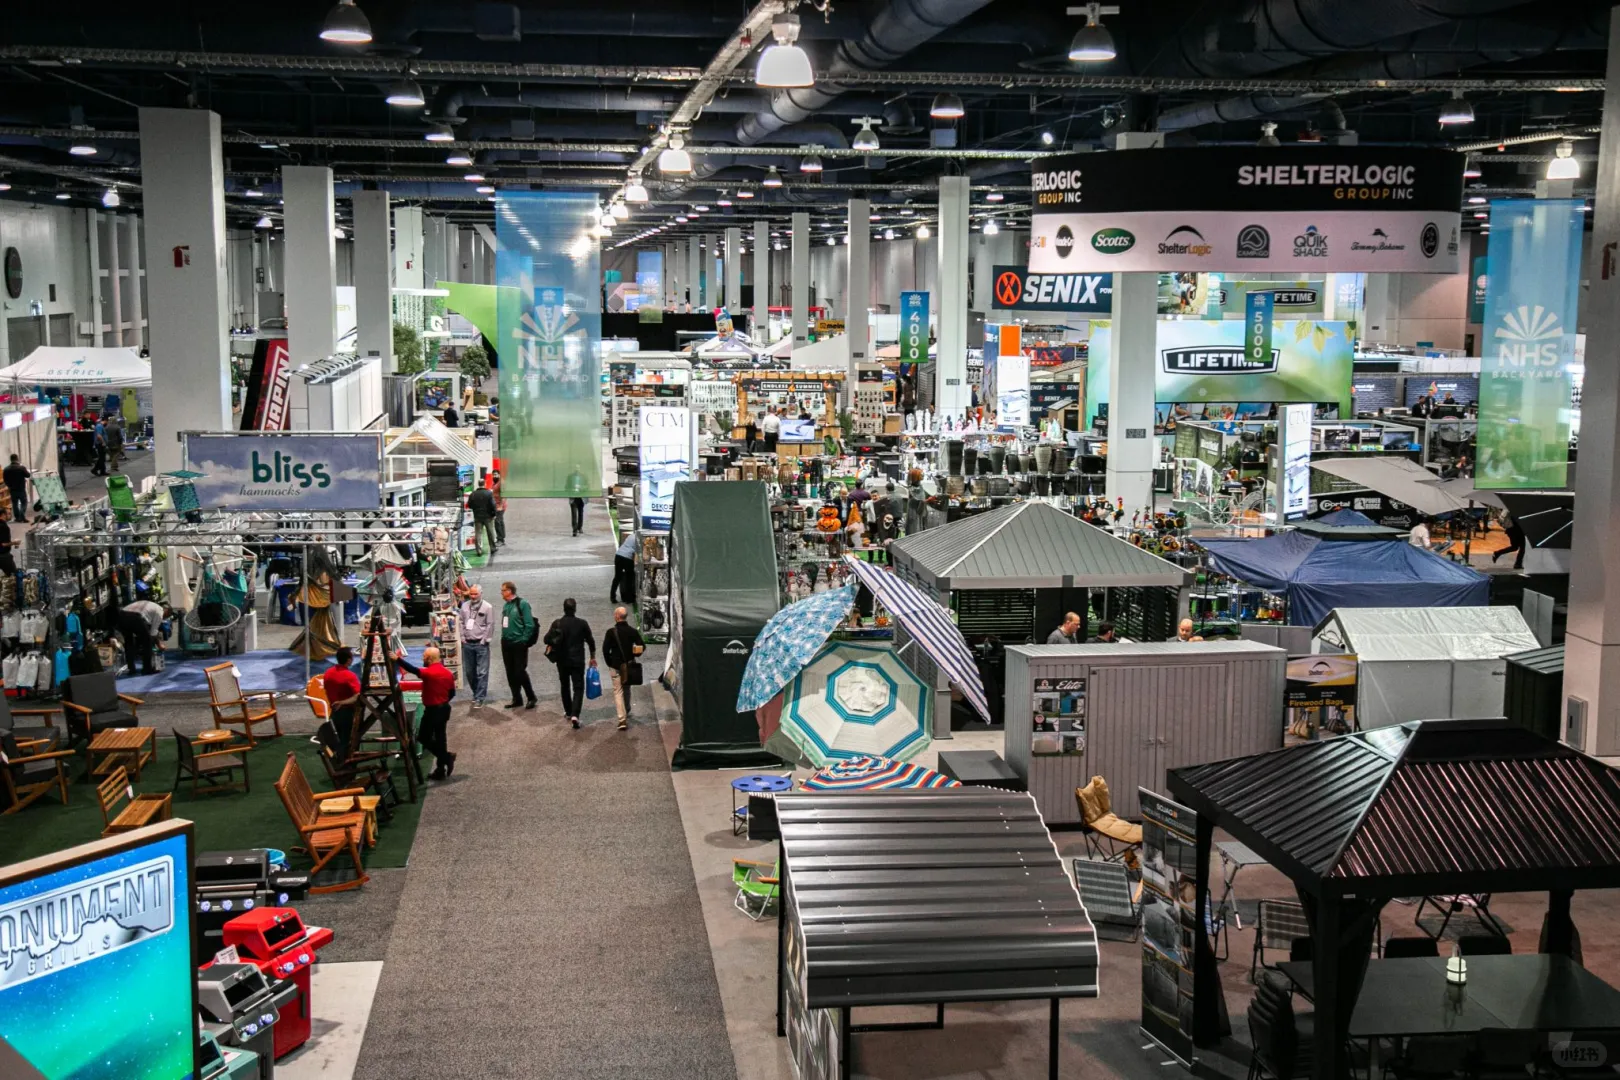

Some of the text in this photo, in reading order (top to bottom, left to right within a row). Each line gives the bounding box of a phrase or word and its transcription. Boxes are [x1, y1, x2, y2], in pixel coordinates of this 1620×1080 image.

[1238, 165, 1415, 185] SHELTERLOGIC
[1095, 234, 1130, 247] Scotts
[1157, 242, 1213, 256] ShelterLogic
[1293, 235, 1329, 248] QUIK
[1292, 247, 1328, 257] SHADE
[1022, 275, 1102, 304] SENIX
[909, 311, 921, 360] 4000
[1253, 311, 1264, 359] 5000
[1498, 343, 1558, 368] NHS
[1492, 370, 1563, 379] BACKYARD
[645, 411, 684, 428] CTM
[252, 450, 331, 488] bliss
[240, 484, 301, 497] hammocks
[1055, 680, 1084, 690] Elite
[27, 933, 112, 977] GRILLS
